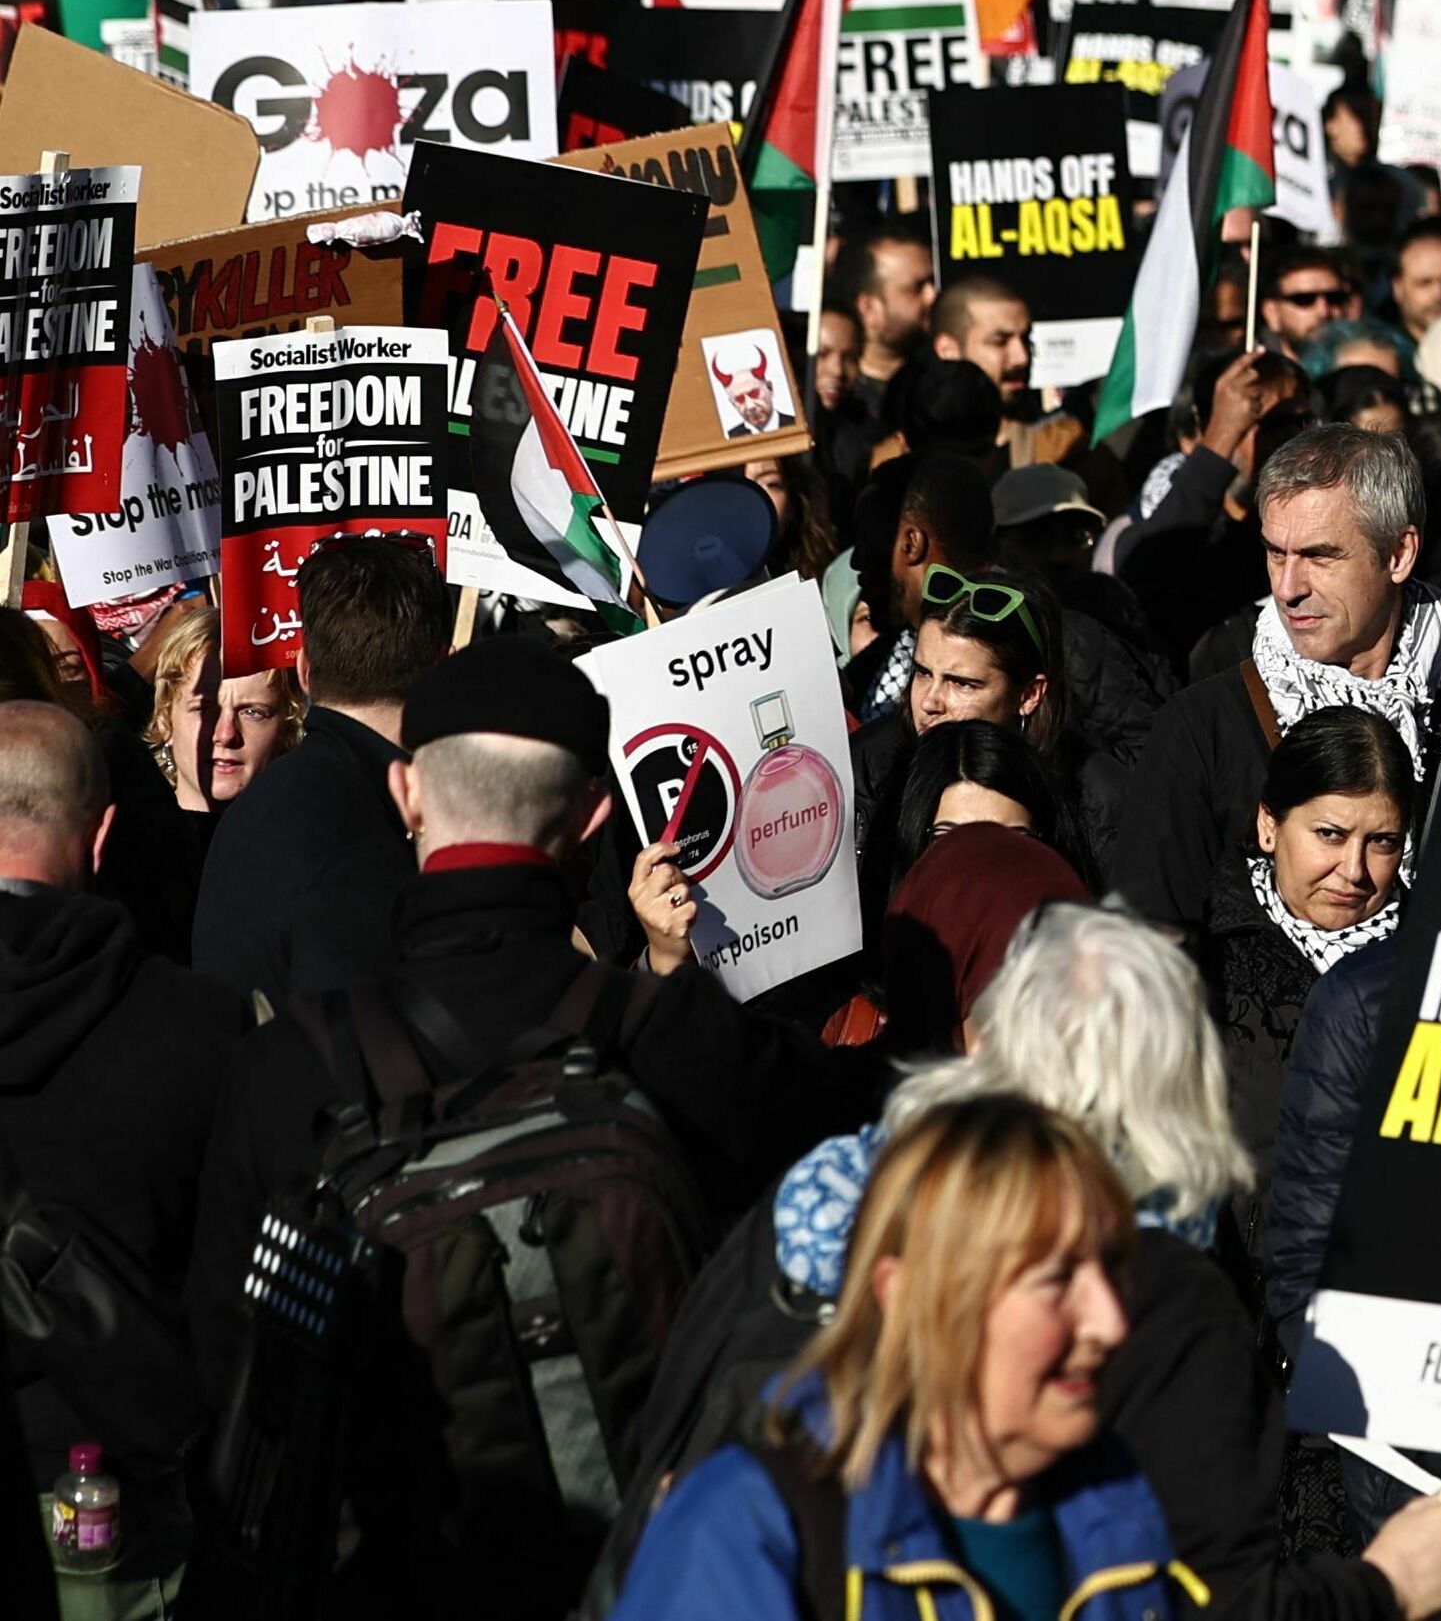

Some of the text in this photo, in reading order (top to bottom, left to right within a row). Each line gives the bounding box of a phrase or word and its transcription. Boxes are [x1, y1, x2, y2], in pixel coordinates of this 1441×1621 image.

[1, 185, 64, 209] Socialist
[949, 153, 1115, 205] HANDS OFF
[950, 194, 1126, 261] AL-AQSA
[41, 278, 61, 304] for
[412, 222, 658, 381] FREE
[250, 343, 337, 370] Socialist
[337, 337, 412, 360] Worker
[240, 375, 422, 441] FREEDOM
[317, 434, 344, 459] for
[147, 483, 182, 519] the
[234, 455, 434, 524] PALESTINE
[102, 569, 133, 585] Stop
[135, 562, 154, 578] the
[154, 558, 173, 573] War
[668, 627, 774, 693] spray
[750, 799, 829, 849] perfume
[728, 915, 799, 967] poison
